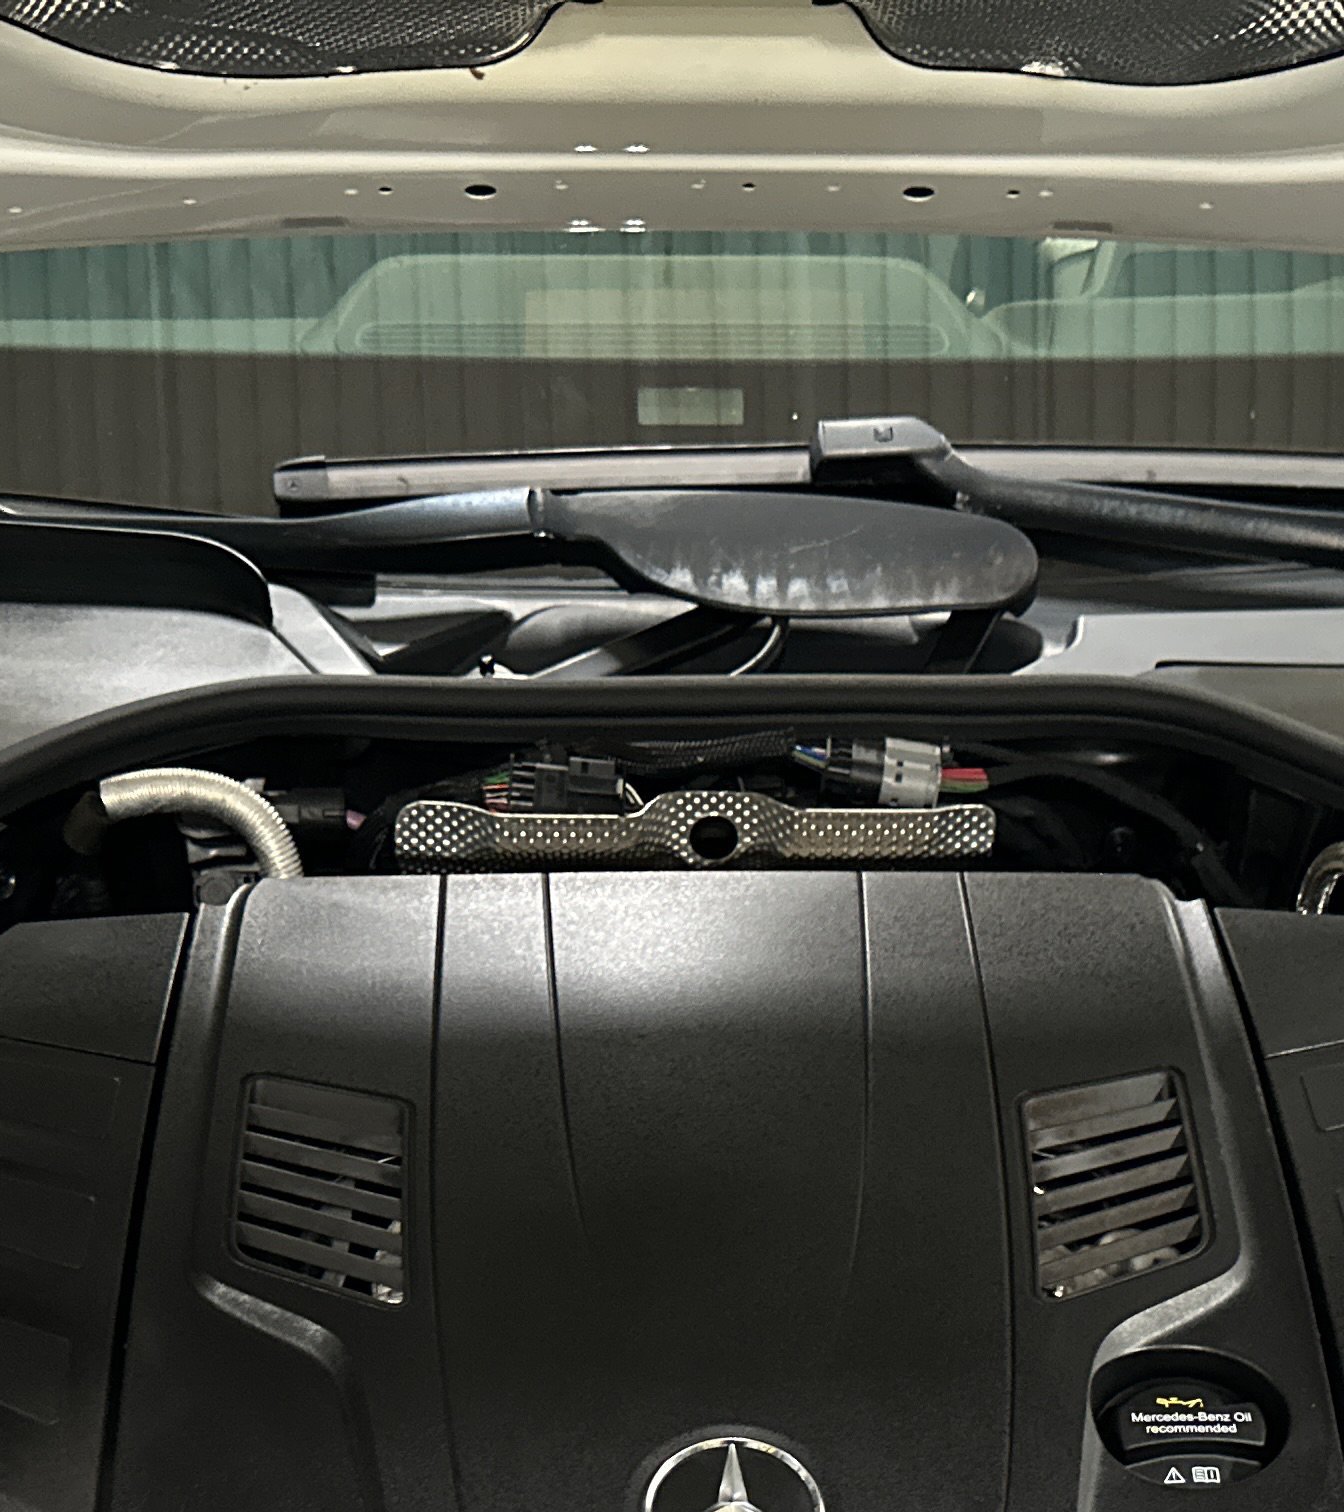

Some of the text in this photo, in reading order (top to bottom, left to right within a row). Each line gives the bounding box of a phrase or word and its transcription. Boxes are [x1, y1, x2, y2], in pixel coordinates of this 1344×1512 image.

[1131, 1411, 1252, 1422] Mercedes-Benz Oil
[1146, 1423, 1237, 1434] recommended
